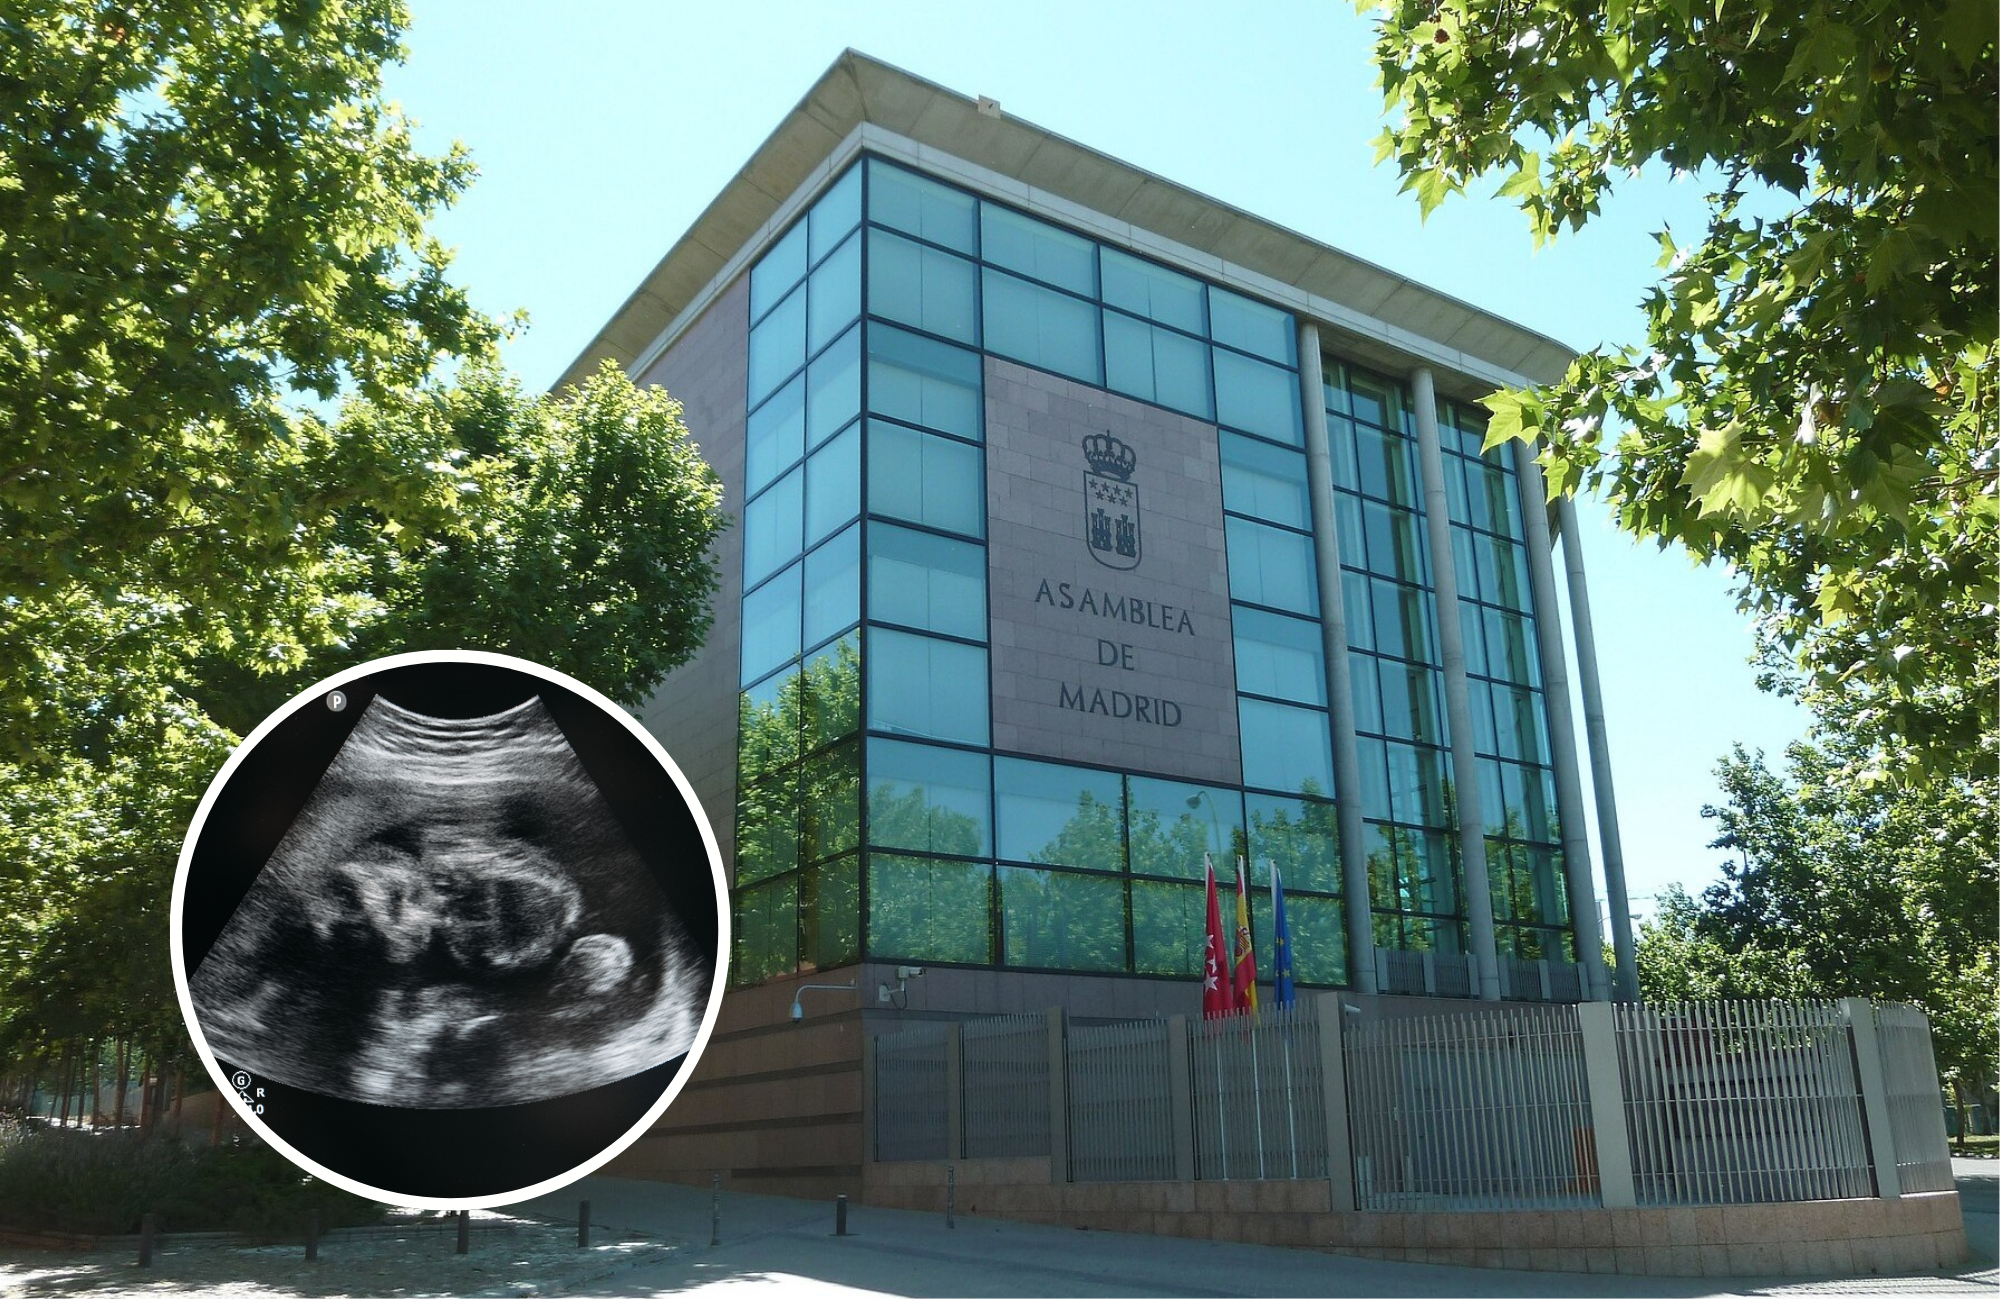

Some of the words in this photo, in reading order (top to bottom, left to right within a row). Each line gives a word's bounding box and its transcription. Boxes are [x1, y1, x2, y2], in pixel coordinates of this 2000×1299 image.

[1035, 578, 1195, 636] ASAMBLEA
[1098, 638, 1135, 671] DE
[1059, 681, 1182, 727] MADRID
